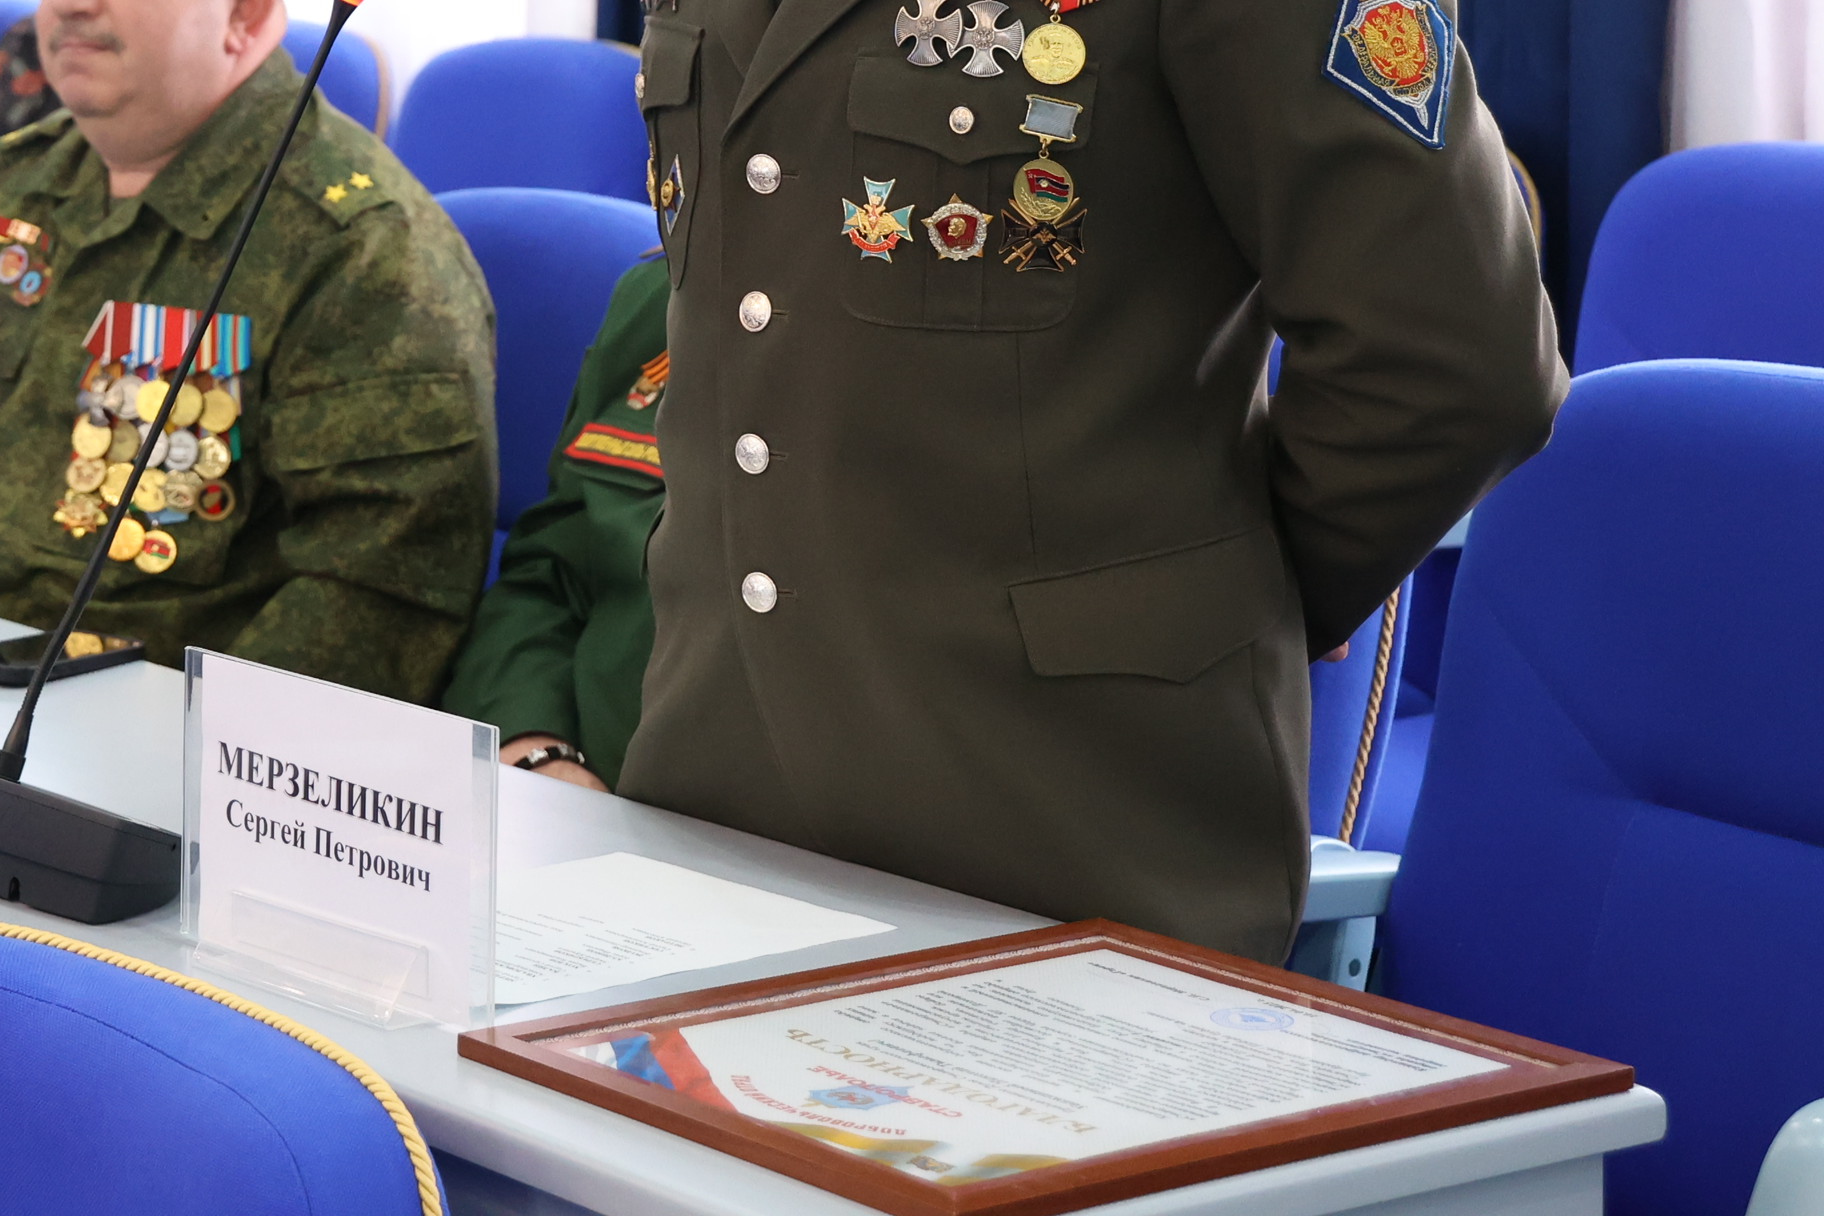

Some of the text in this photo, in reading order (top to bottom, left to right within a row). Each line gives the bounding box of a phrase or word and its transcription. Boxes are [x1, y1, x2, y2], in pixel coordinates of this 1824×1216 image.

[217, 740, 444, 845] МЕРЗЕЛИКИН
[225, 798, 431, 892] Сергей Петрович
[787, 1028, 1098, 1135] БЛАГОДАРНОСТЬ
[811, 1065, 963, 1120] СТАВРОПОЛЬЕ
